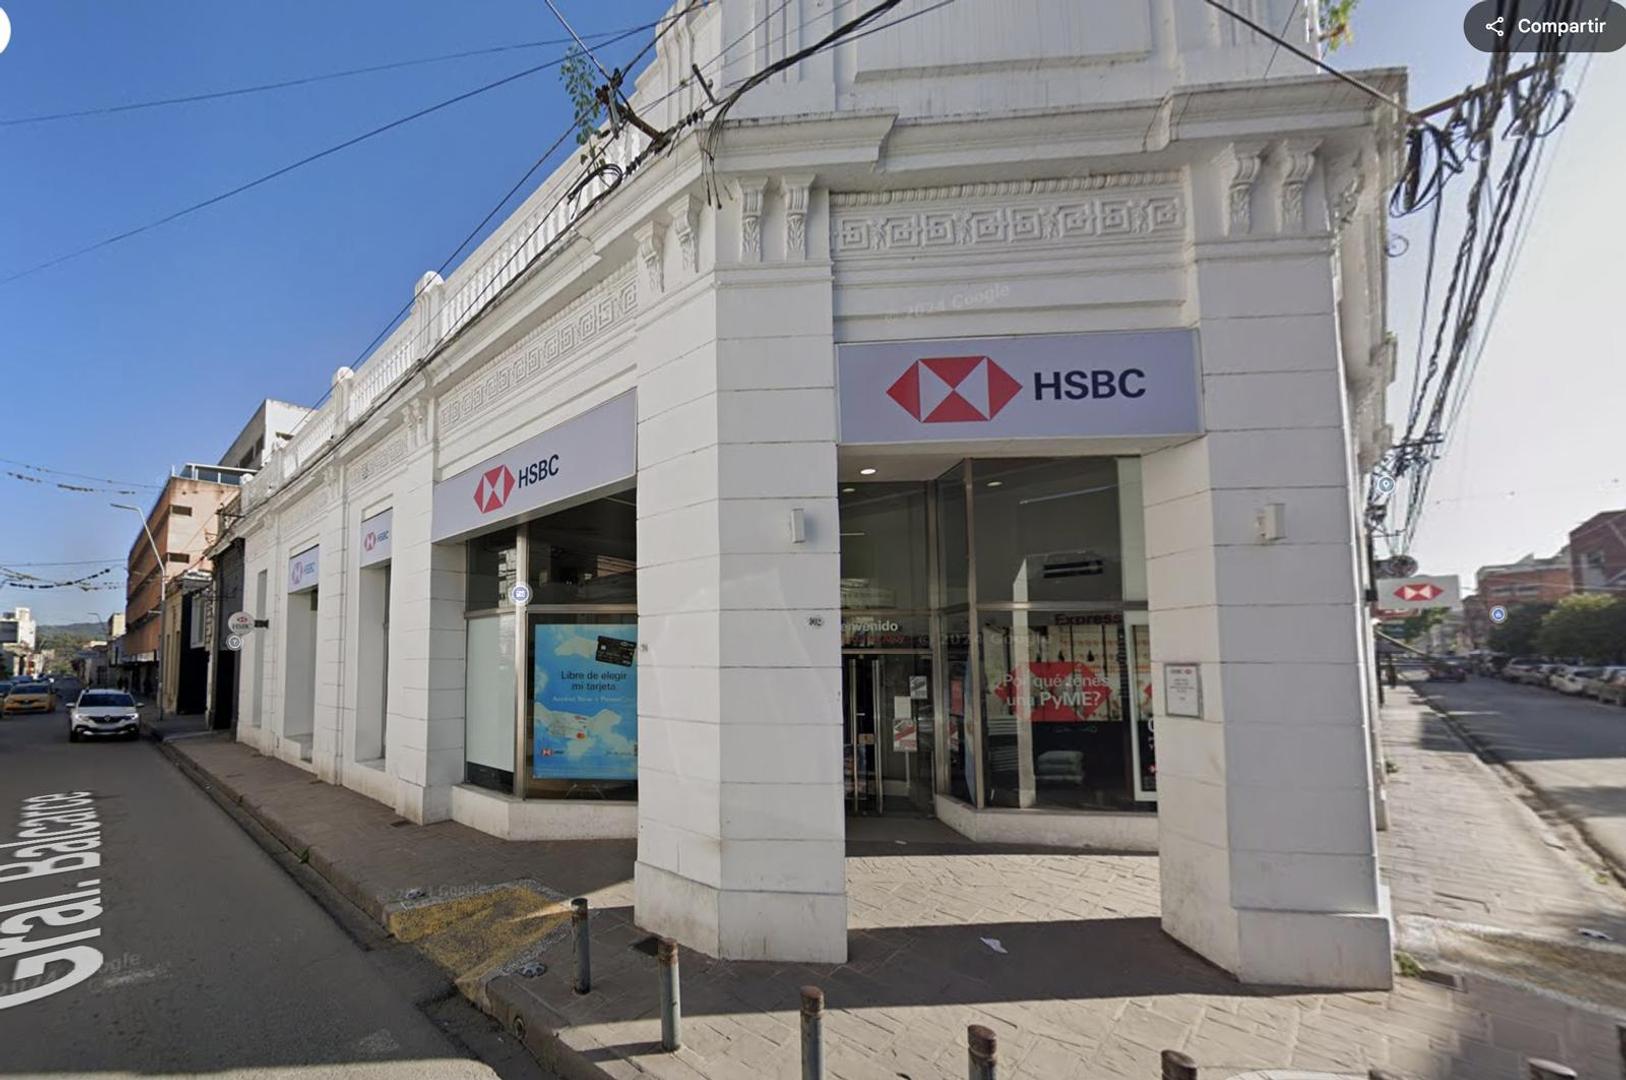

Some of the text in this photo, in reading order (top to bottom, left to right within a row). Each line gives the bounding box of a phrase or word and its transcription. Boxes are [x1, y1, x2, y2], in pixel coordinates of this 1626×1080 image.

[1034, 368, 1146, 401] HSBC
[518, 454, 559, 489] HSBC
[1055, 612, 1122, 625] Express
[560, 670, 627, 682] Libre de elegir
[1034, 673, 1061, 691] qué
[571, 682, 616, 693] mi tarjeta
[1040, 690, 1101, 711] PyME?
